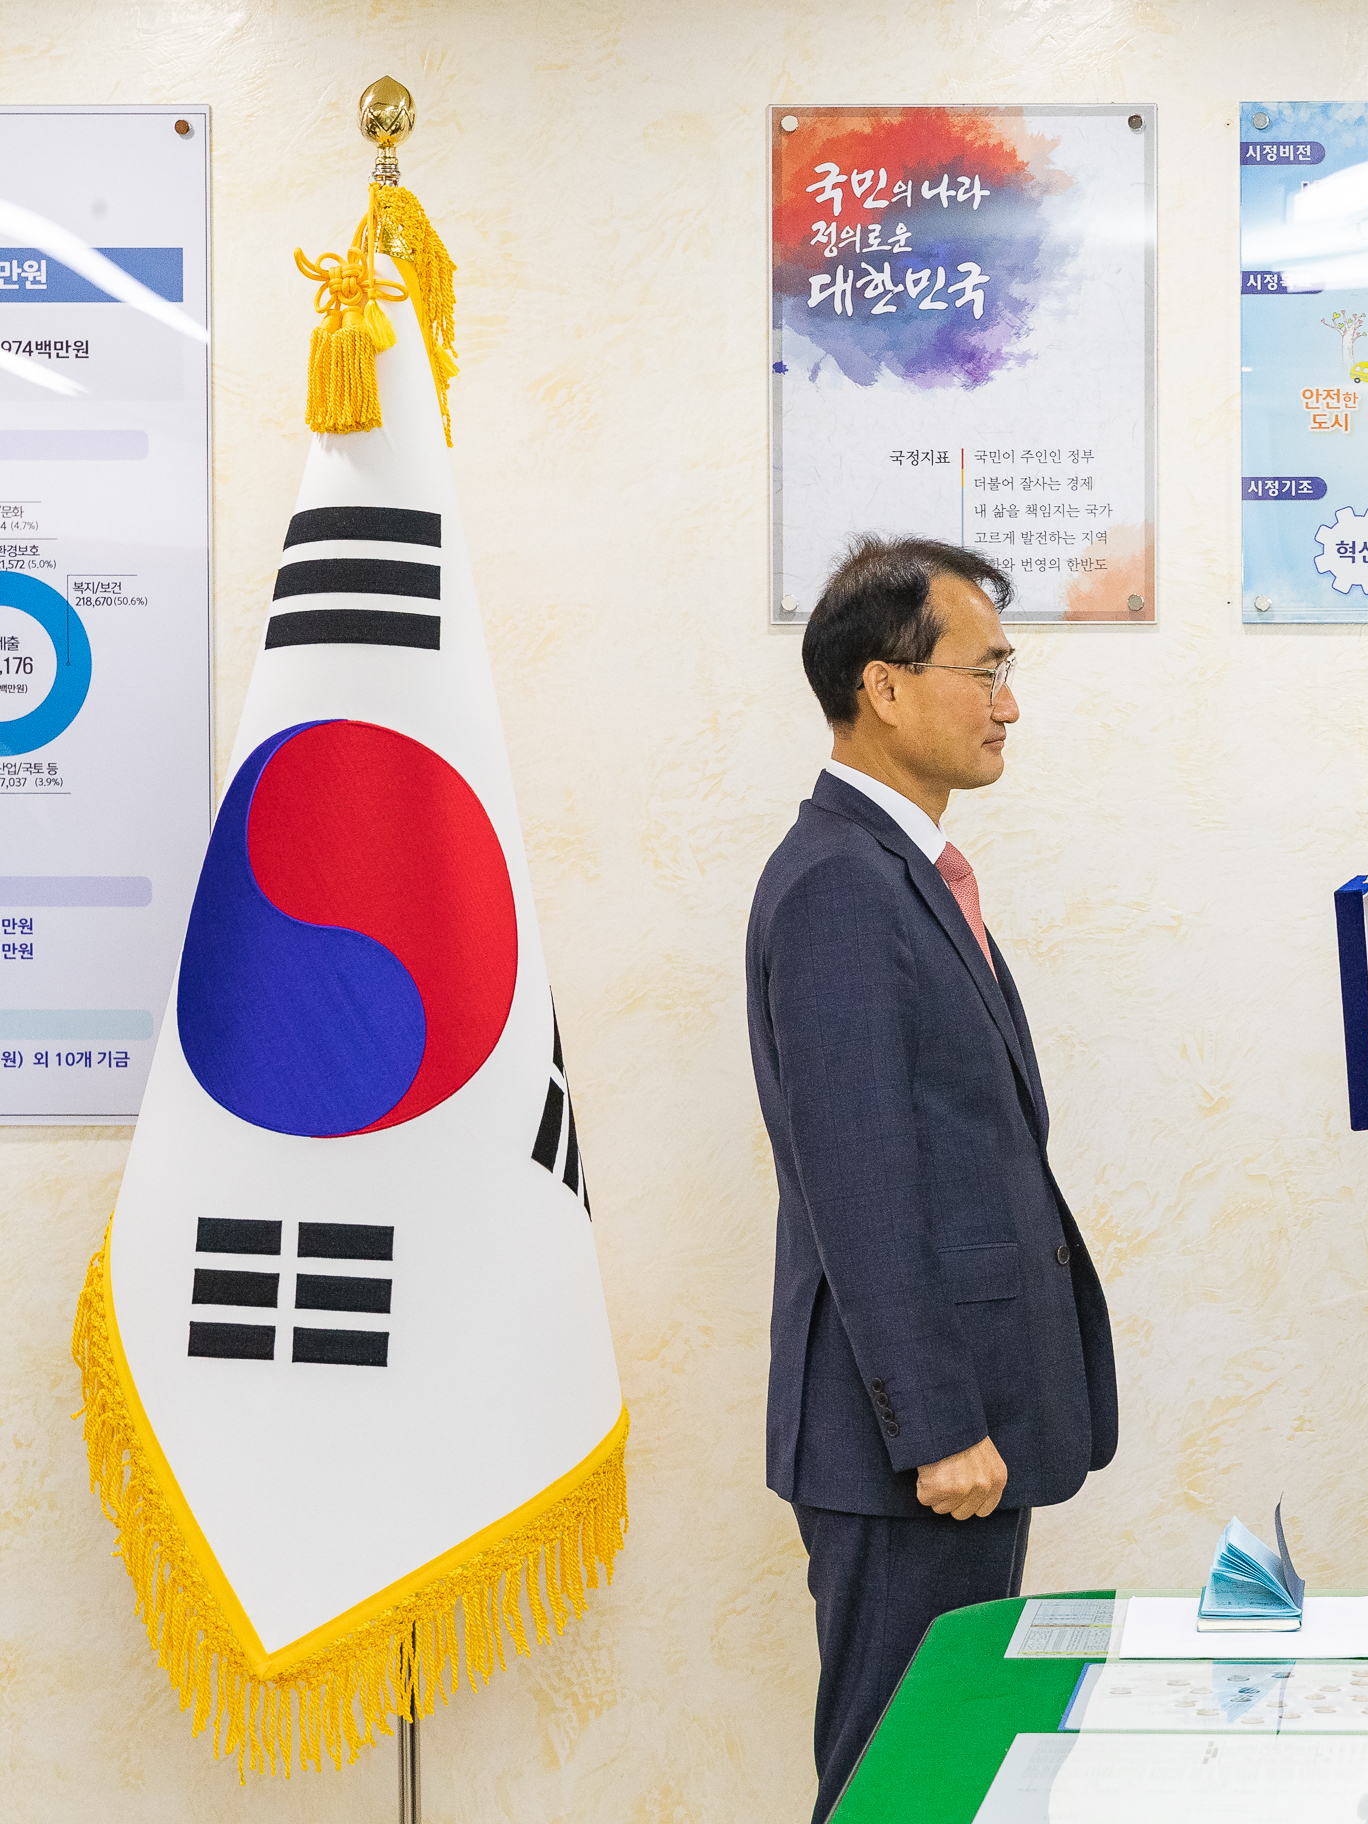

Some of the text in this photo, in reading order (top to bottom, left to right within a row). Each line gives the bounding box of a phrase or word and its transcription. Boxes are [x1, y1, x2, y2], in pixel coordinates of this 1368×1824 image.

[1246, 144, 1312, 161] 시정비전
[805, 162, 990, 216] 국민의 나라
[810, 221, 912, 258] 정의로운
[806, 261, 991, 320] 대한민국
[1247, 274, 1312, 291] 시정목
[1, 340, 90, 359] 974백만원
[1302, 388, 1359, 411] 안전한
[1310, 414, 1350, 432] 도시
[889, 449, 951, 466] 국정지표
[974, 449, 1095, 465] 국민이 주인인 정부
[974, 476, 1093, 492] 더불어 잘사는 경제
[1248, 480, 1314, 496] 시정기조
[974, 503, 1113, 518] 내 삶을 책임지는 국가
[10, 521, 39, 532] (4.7%)
[974, 531, 1108, 545] 고르게 발전하는 지역
[0, 559, 57, 571] 1,572 (5.0%)
[1020, 557, 1061, 572] 번영의
[1067, 557, 1108, 572] 한반도
[73, 581, 122, 595] 복지/보건
[47, 762, 58, 776] 등
[35, 777, 64, 788] (3.9%)
[2, 918, 33, 935] 만원
[2, 943, 33, 960] 만원
[1, 1051, 130, 1068] 원) 외 10개 기금
